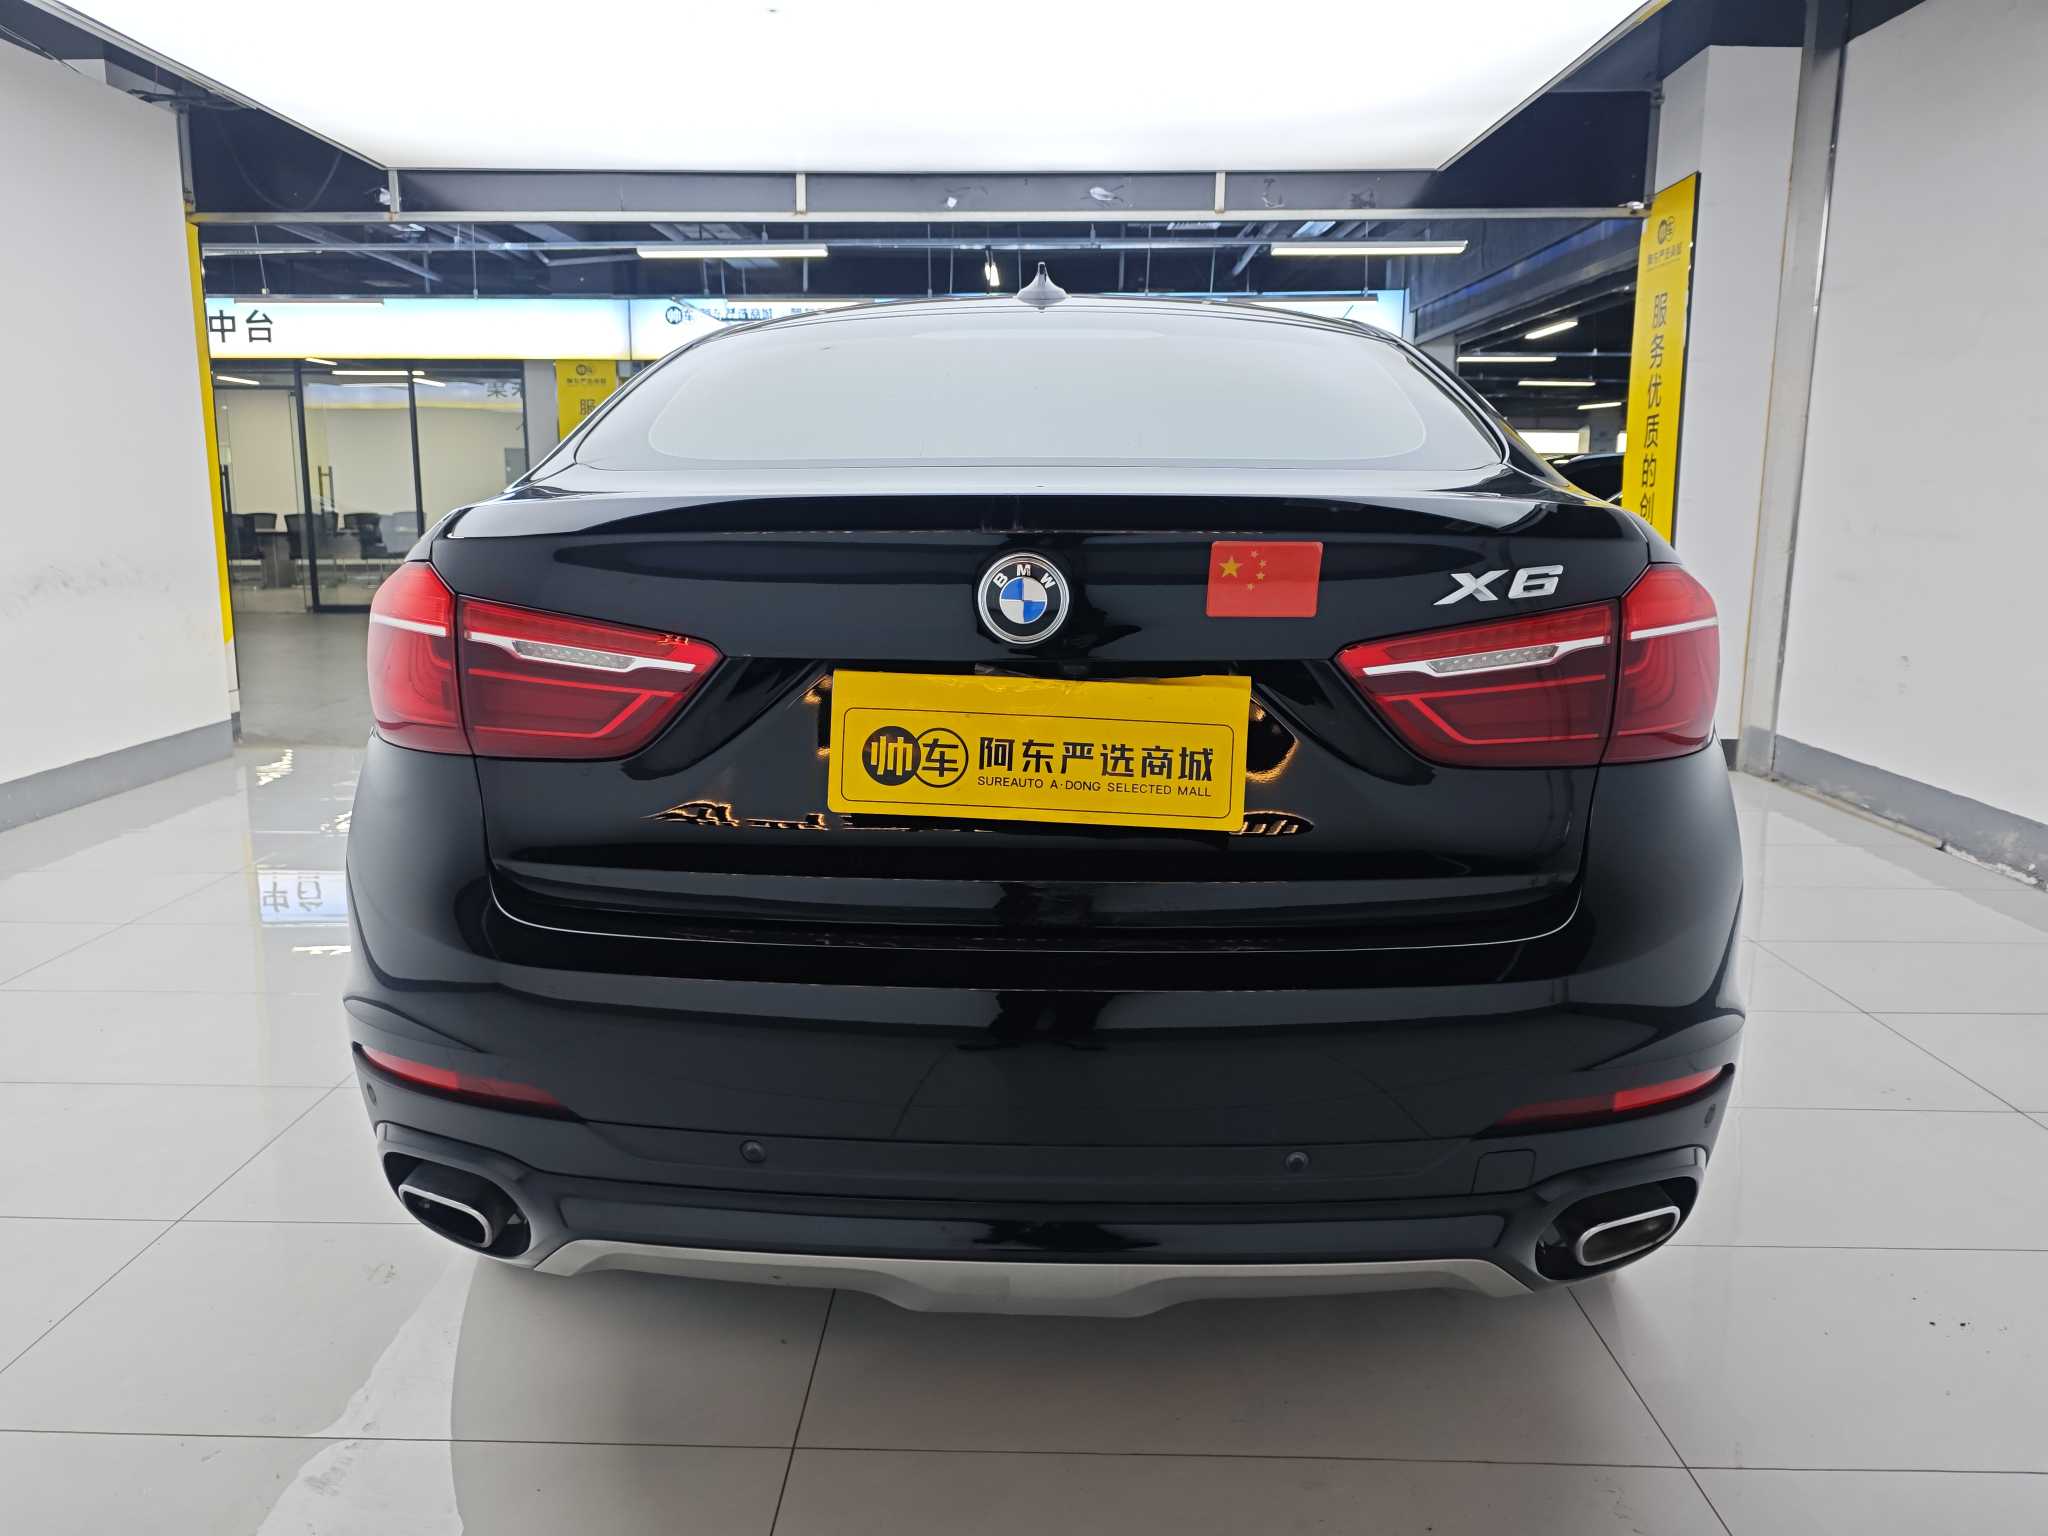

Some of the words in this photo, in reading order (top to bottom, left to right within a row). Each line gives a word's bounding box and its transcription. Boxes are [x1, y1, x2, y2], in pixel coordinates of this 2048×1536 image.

[208, 309, 273, 343] 中台
[1639, 292, 1668, 525] 服务优质的创
[993, 564, 1056, 589] BMW
[1433, 565, 1564, 605] X6
[978, 736, 1214, 782] 阿东严选商城
[977, 775, 1044, 789] SUREAUTO
[1107, 782, 1172, 795] SELECTED
[1177, 786, 1212, 798] MALL
